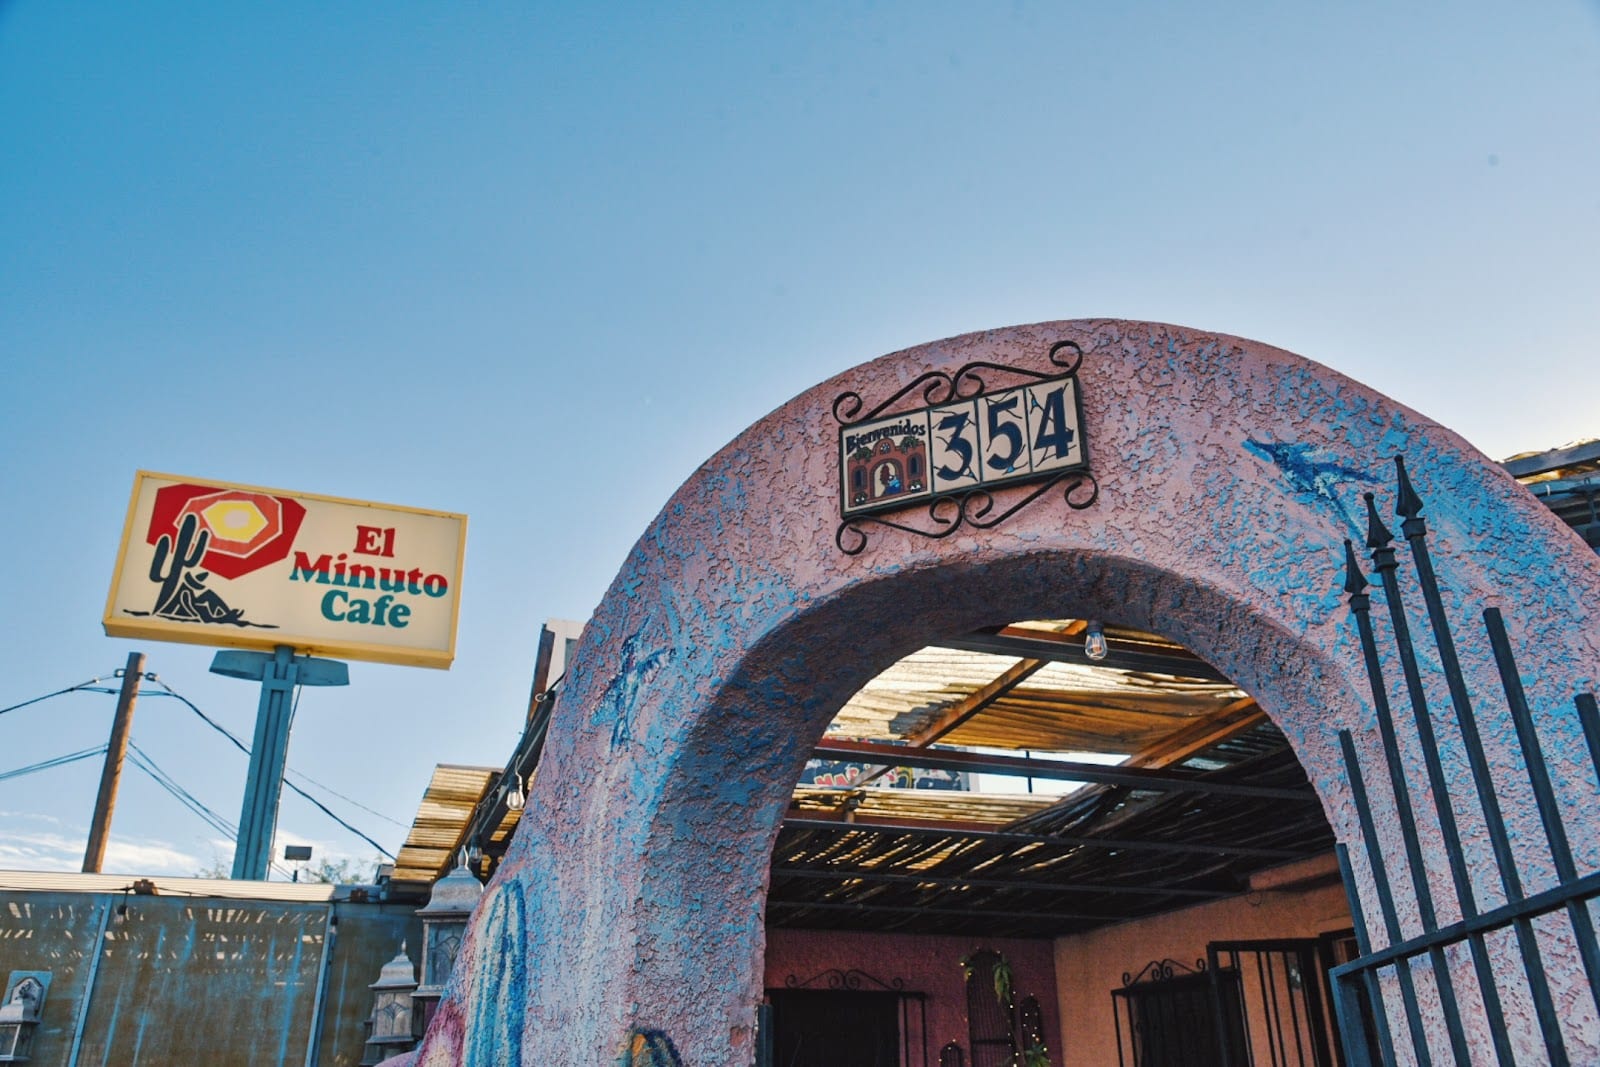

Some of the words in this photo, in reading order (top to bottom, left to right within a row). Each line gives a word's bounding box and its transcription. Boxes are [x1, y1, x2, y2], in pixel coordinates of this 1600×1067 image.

[846, 419, 926, 455] Bienvenidos
[937, 387, 1074, 480] 354
[353, 525, 396, 557] El
[289, 551, 448, 598] Minuto
[321, 589, 411, 628] Cafe
